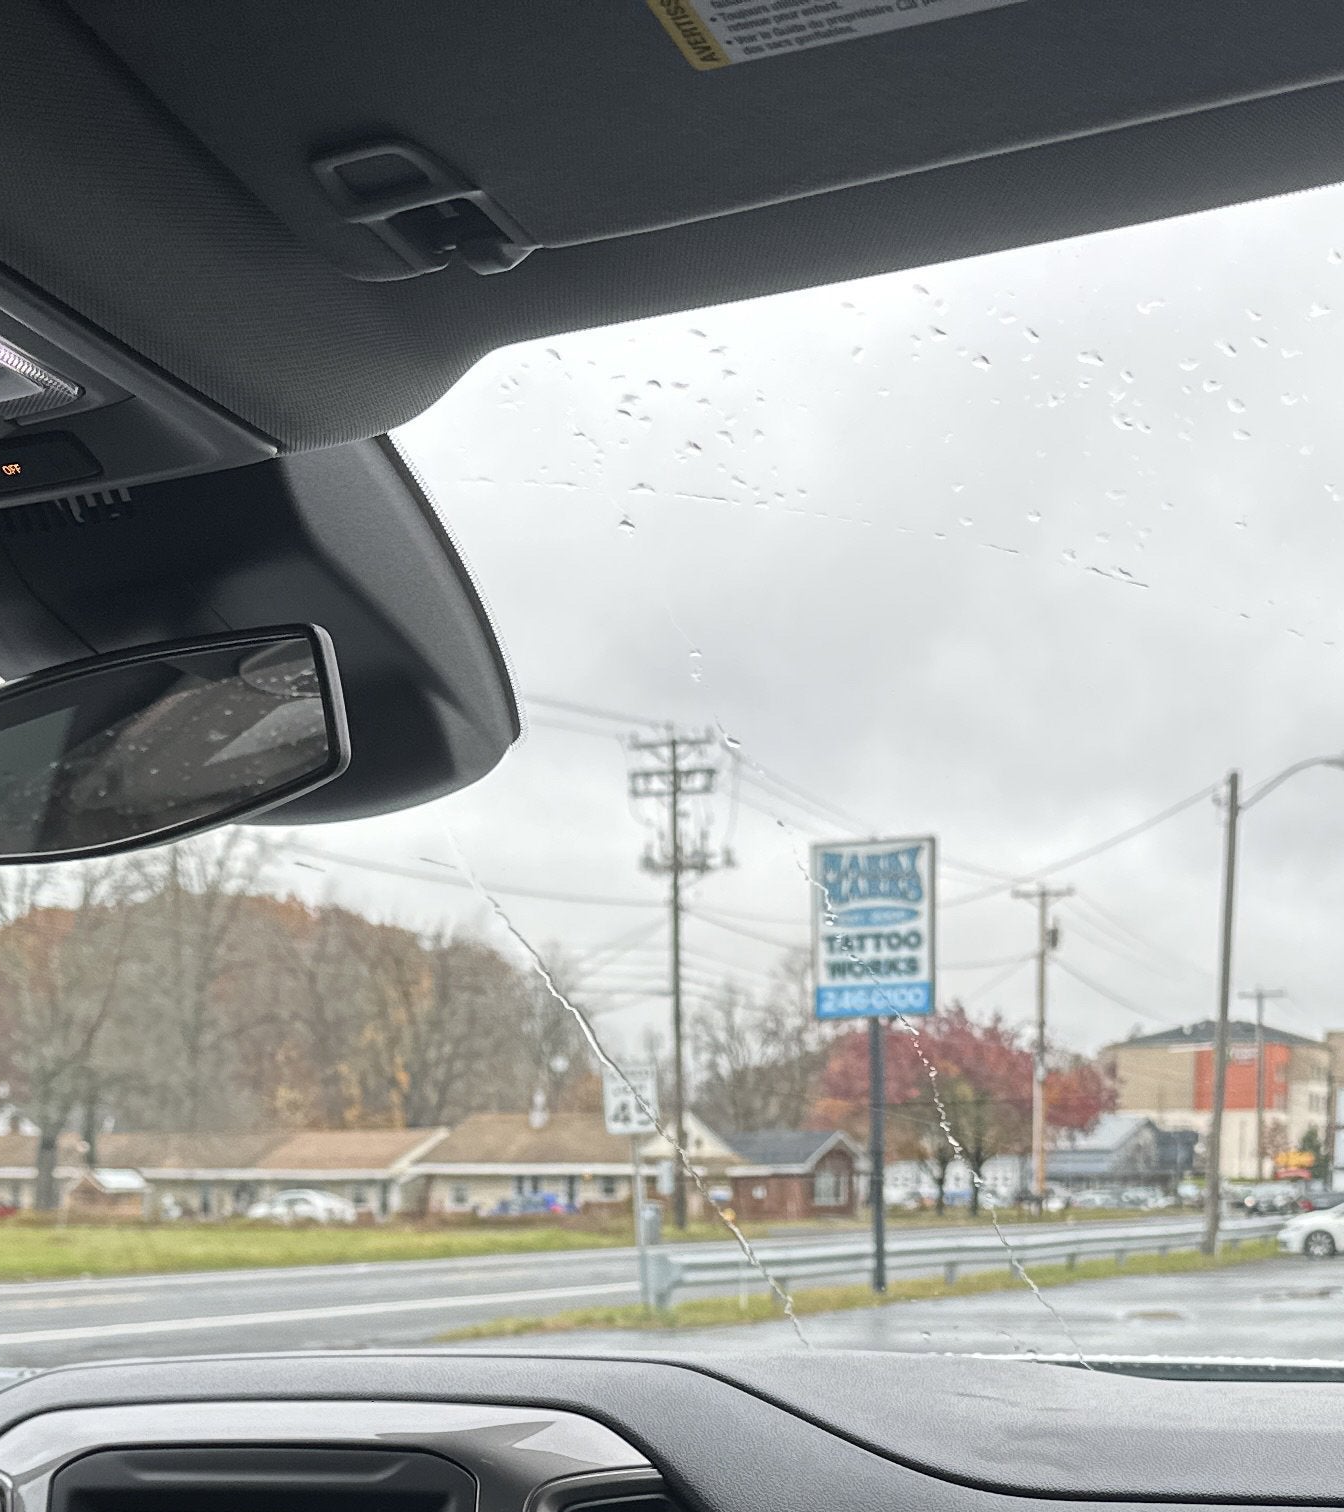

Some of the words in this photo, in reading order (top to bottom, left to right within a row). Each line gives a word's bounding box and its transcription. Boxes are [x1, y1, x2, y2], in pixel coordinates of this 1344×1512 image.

[1, 463, 22, 476] OFF
[825, 931, 922, 954] TATTOO
[827, 956, 919, 979] WORKS
